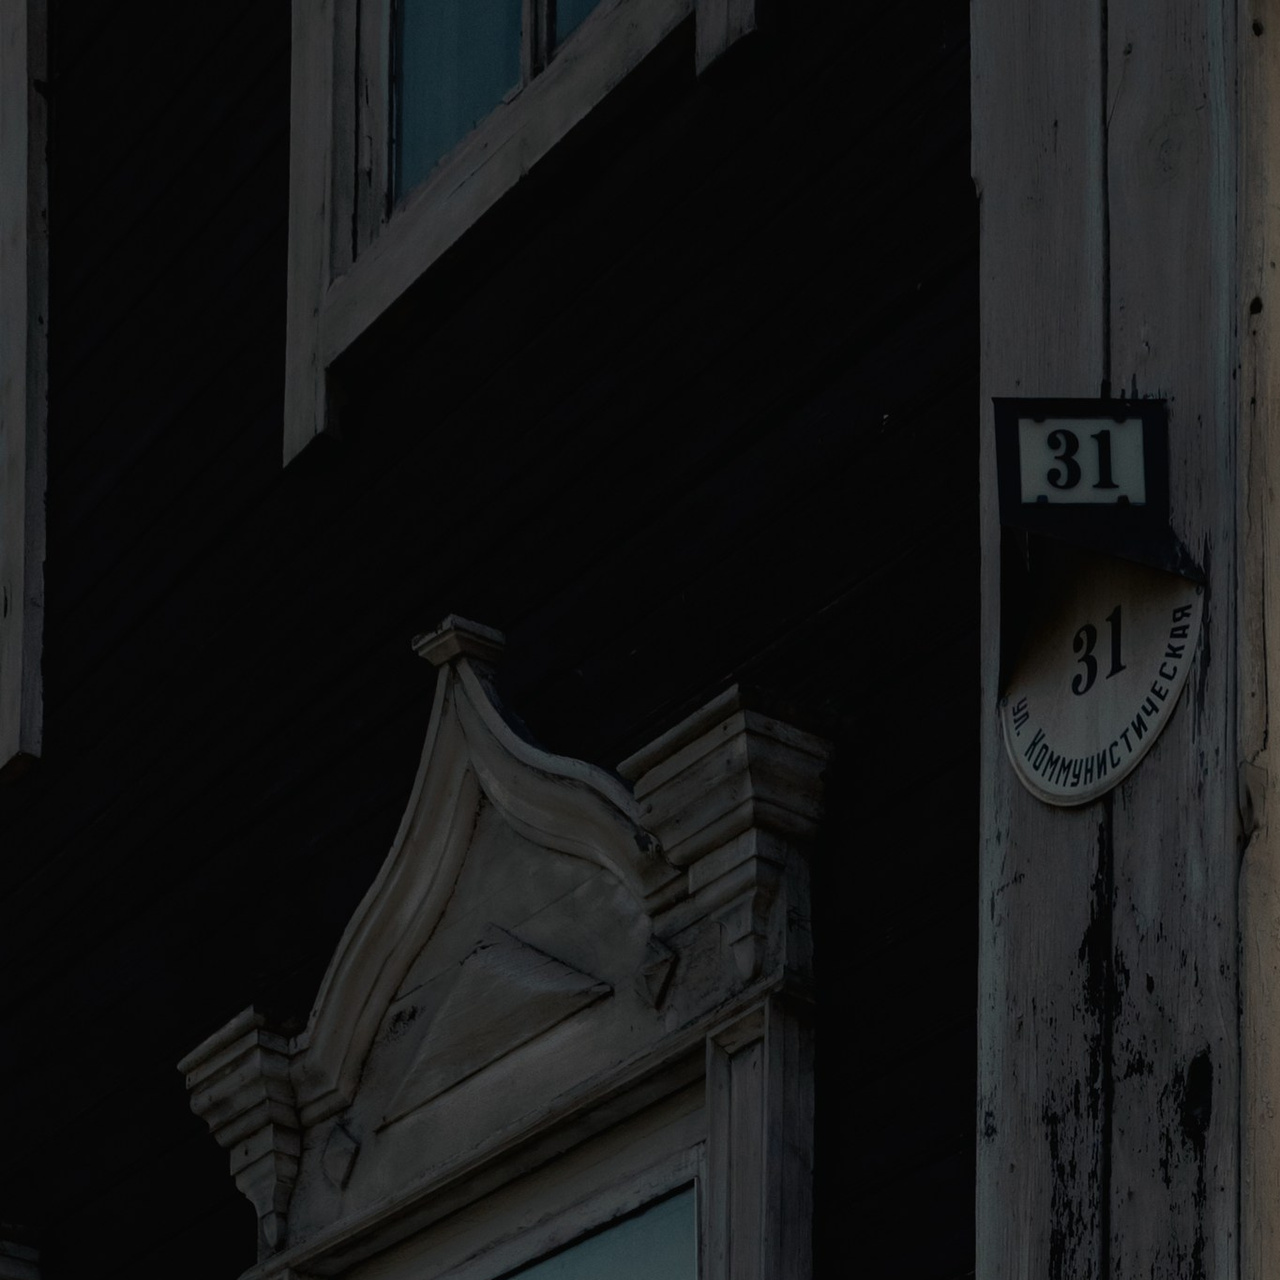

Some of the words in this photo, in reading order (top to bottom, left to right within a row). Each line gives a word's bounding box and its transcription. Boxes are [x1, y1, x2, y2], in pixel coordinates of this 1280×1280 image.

[1046, 429, 1119, 489] 31
[1024, 604, 1193, 787] КОММУНИСТИЧЕСКАЯ
[1072, 604, 1127, 696] 31
